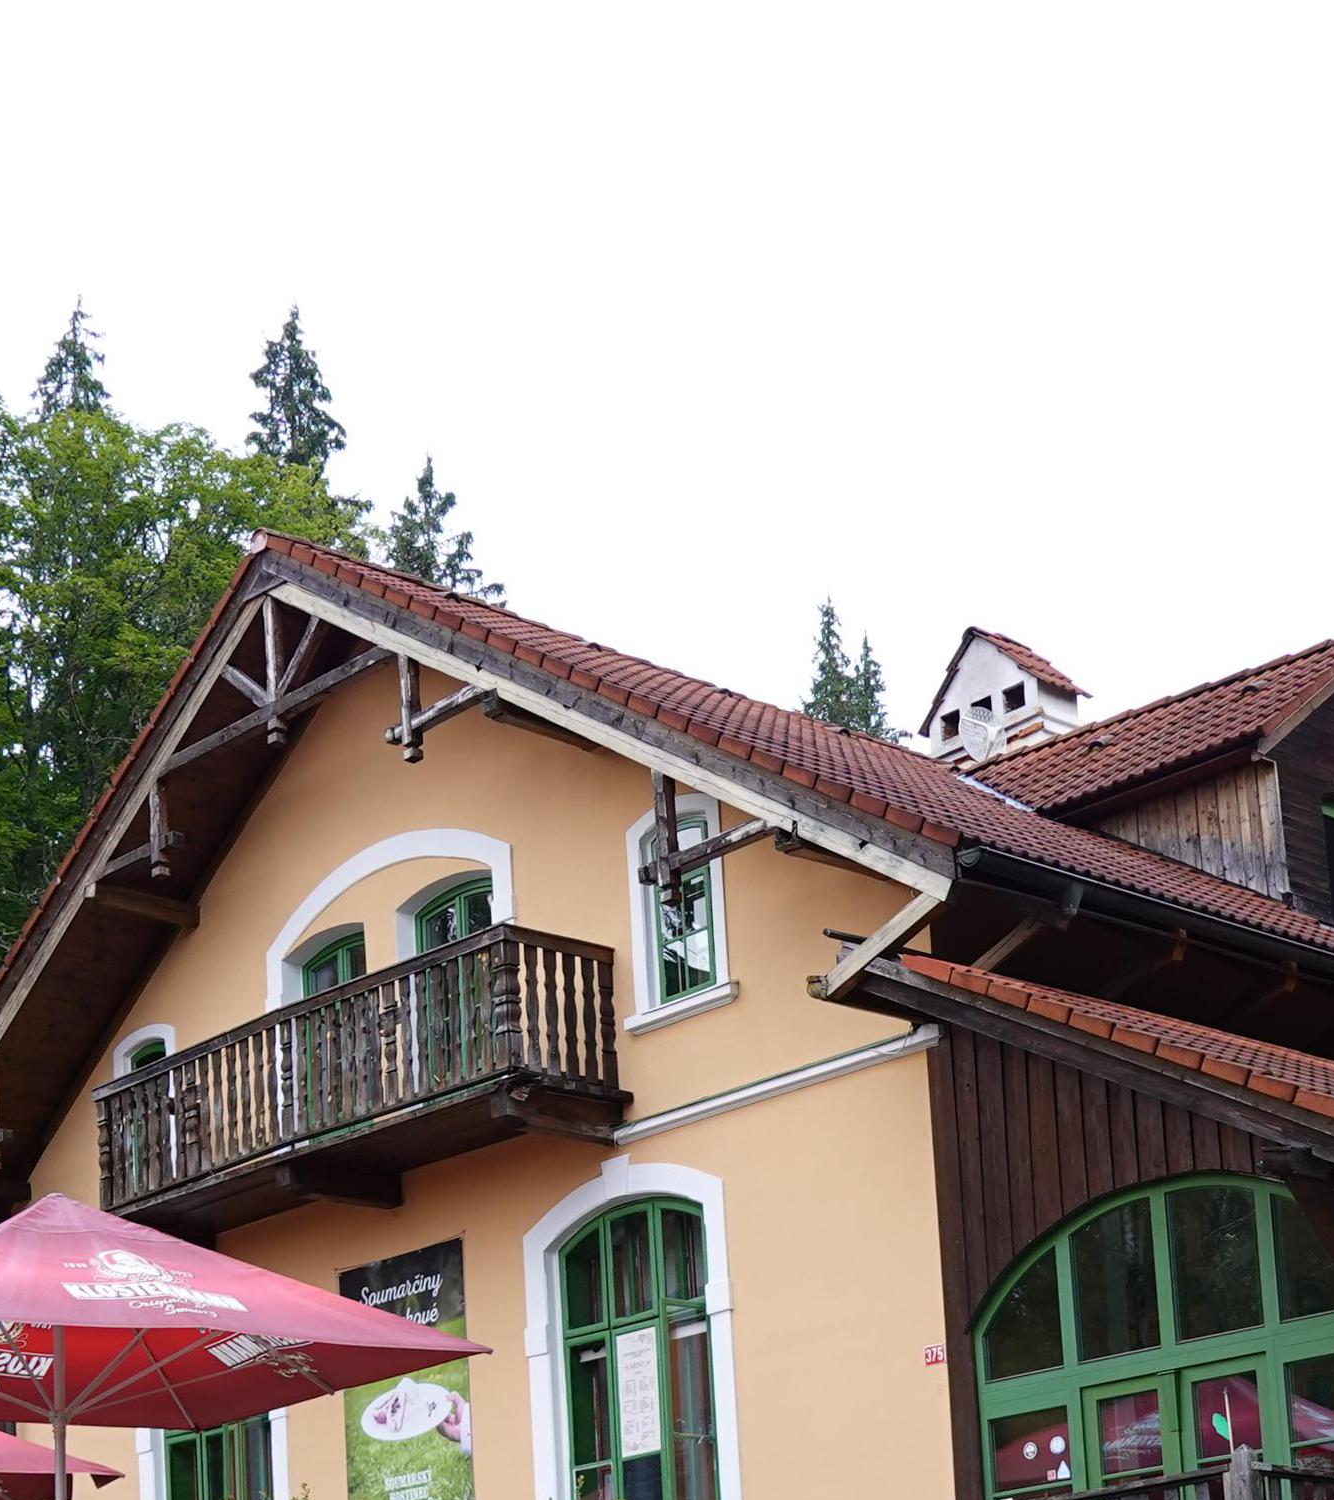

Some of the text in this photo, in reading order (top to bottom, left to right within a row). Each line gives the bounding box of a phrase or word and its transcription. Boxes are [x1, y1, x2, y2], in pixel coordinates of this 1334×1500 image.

[360, 1274, 443, 1307] Soumarčiny
[925, 1346, 943, 1363] 375
[384, 1465, 433, 1491] SOUMARSKÝ
